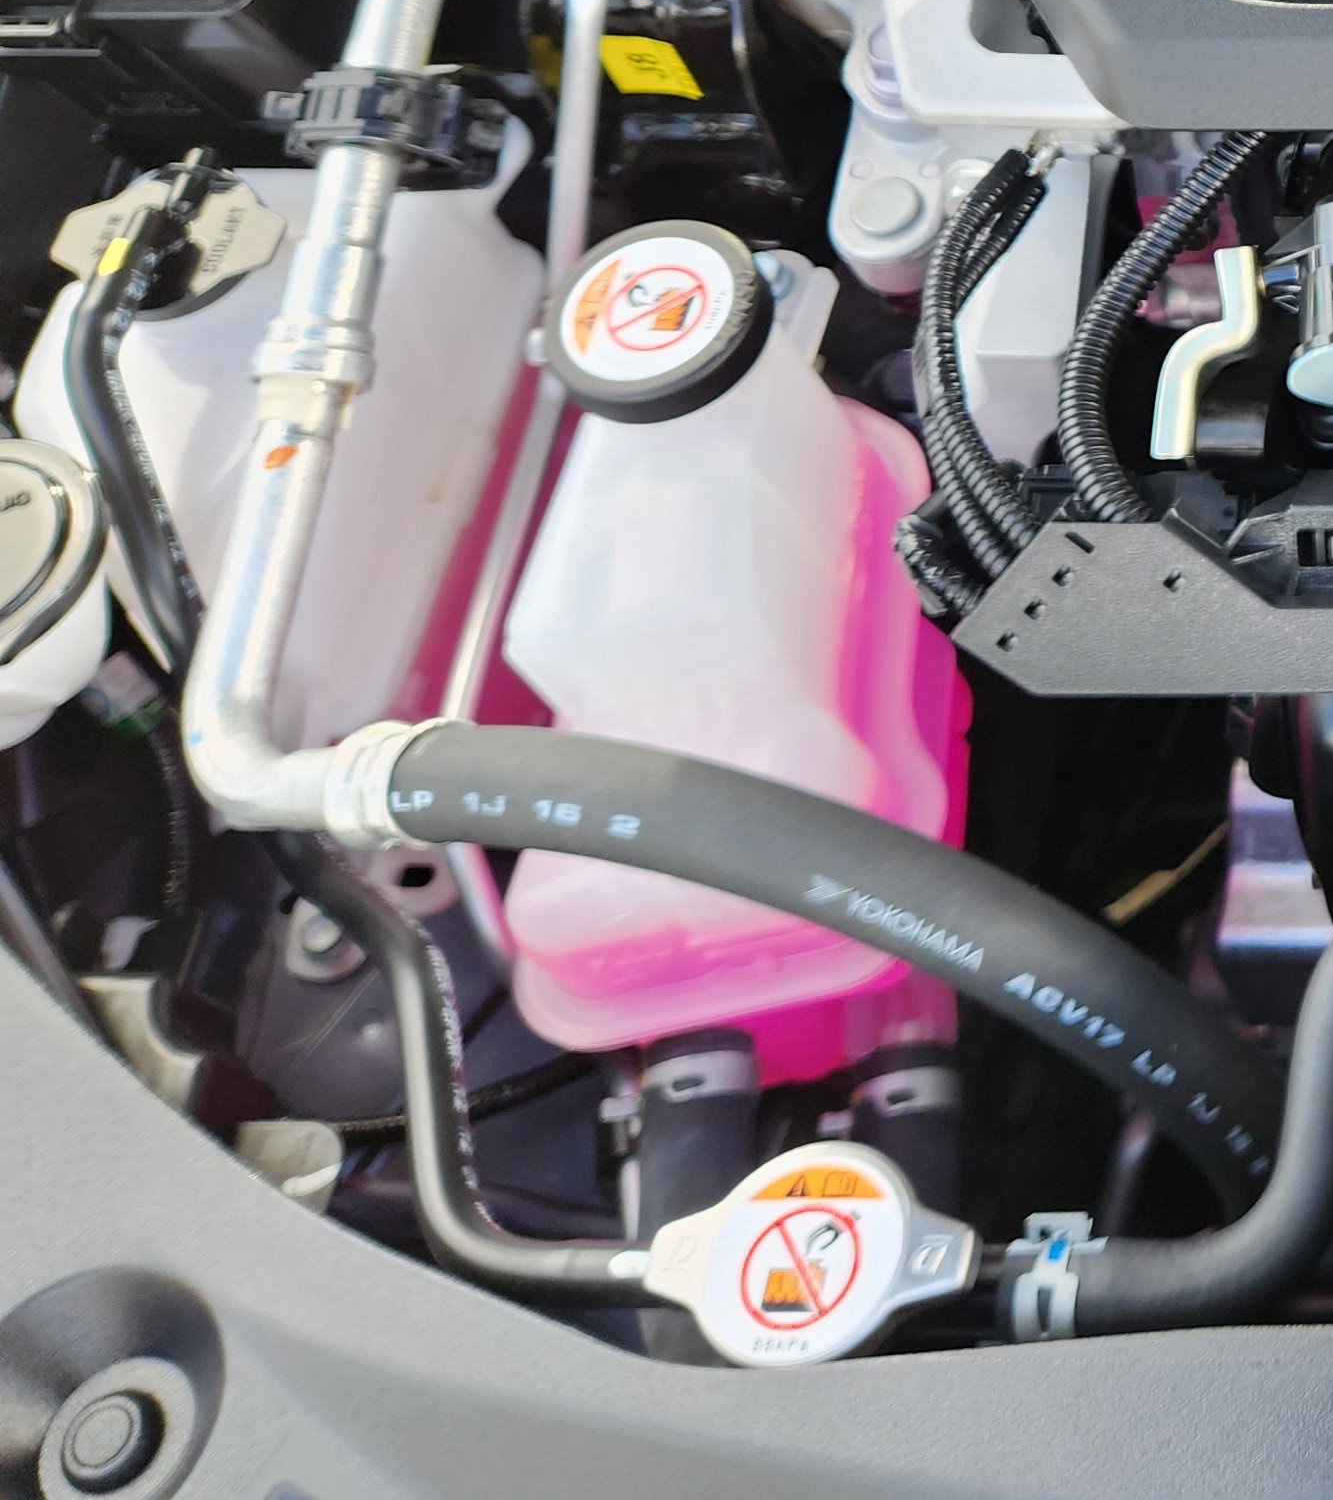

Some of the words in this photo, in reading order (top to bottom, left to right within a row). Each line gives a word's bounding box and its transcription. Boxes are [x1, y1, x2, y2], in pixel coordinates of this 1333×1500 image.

[389, 790, 434, 812] LP
[606, 813, 642, 840] 2
[846, 888, 986, 974] YOKOHAMA
